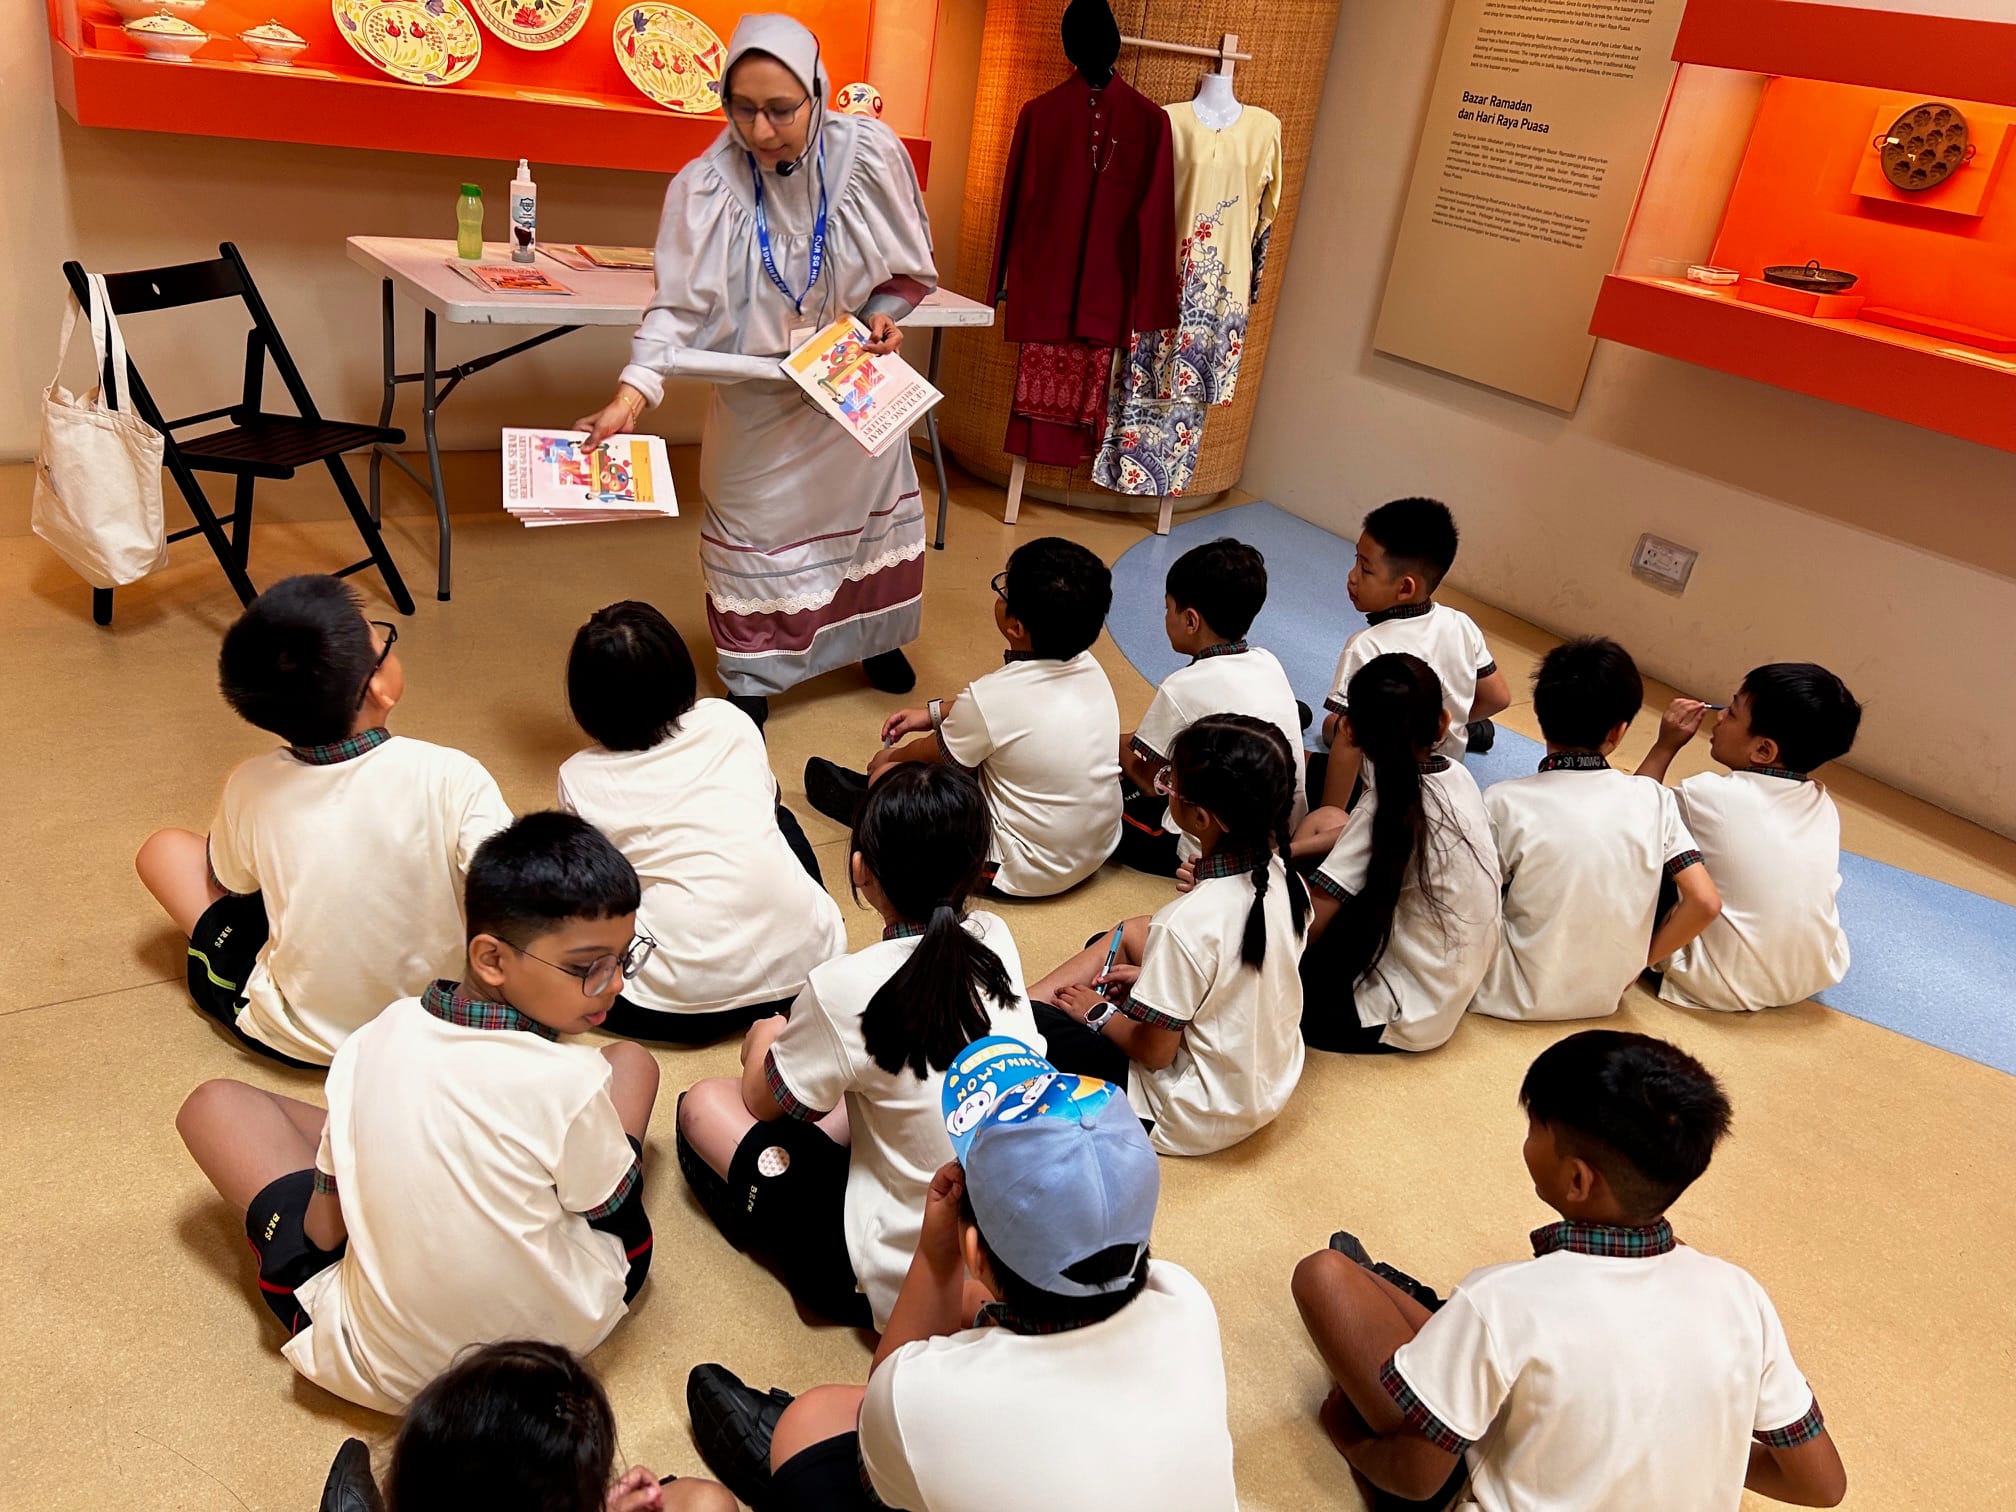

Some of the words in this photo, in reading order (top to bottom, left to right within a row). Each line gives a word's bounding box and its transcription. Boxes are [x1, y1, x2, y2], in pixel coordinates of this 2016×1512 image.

[1462, 91, 1488, 105] Bazar
[1490, 95, 1532, 112] Ramadan
[1458, 108, 1474, 121] dan
[1476, 110, 1496, 124] Hari
[1497, 114, 1519, 130] Raya
[1520, 118, 1550, 133] Puasa
[812, 254, 821, 267] SG
[890, 387, 927, 422] GEYLANG
[866, 418, 892, 443] SERAI
[1563, 757, 1574, 767] US
